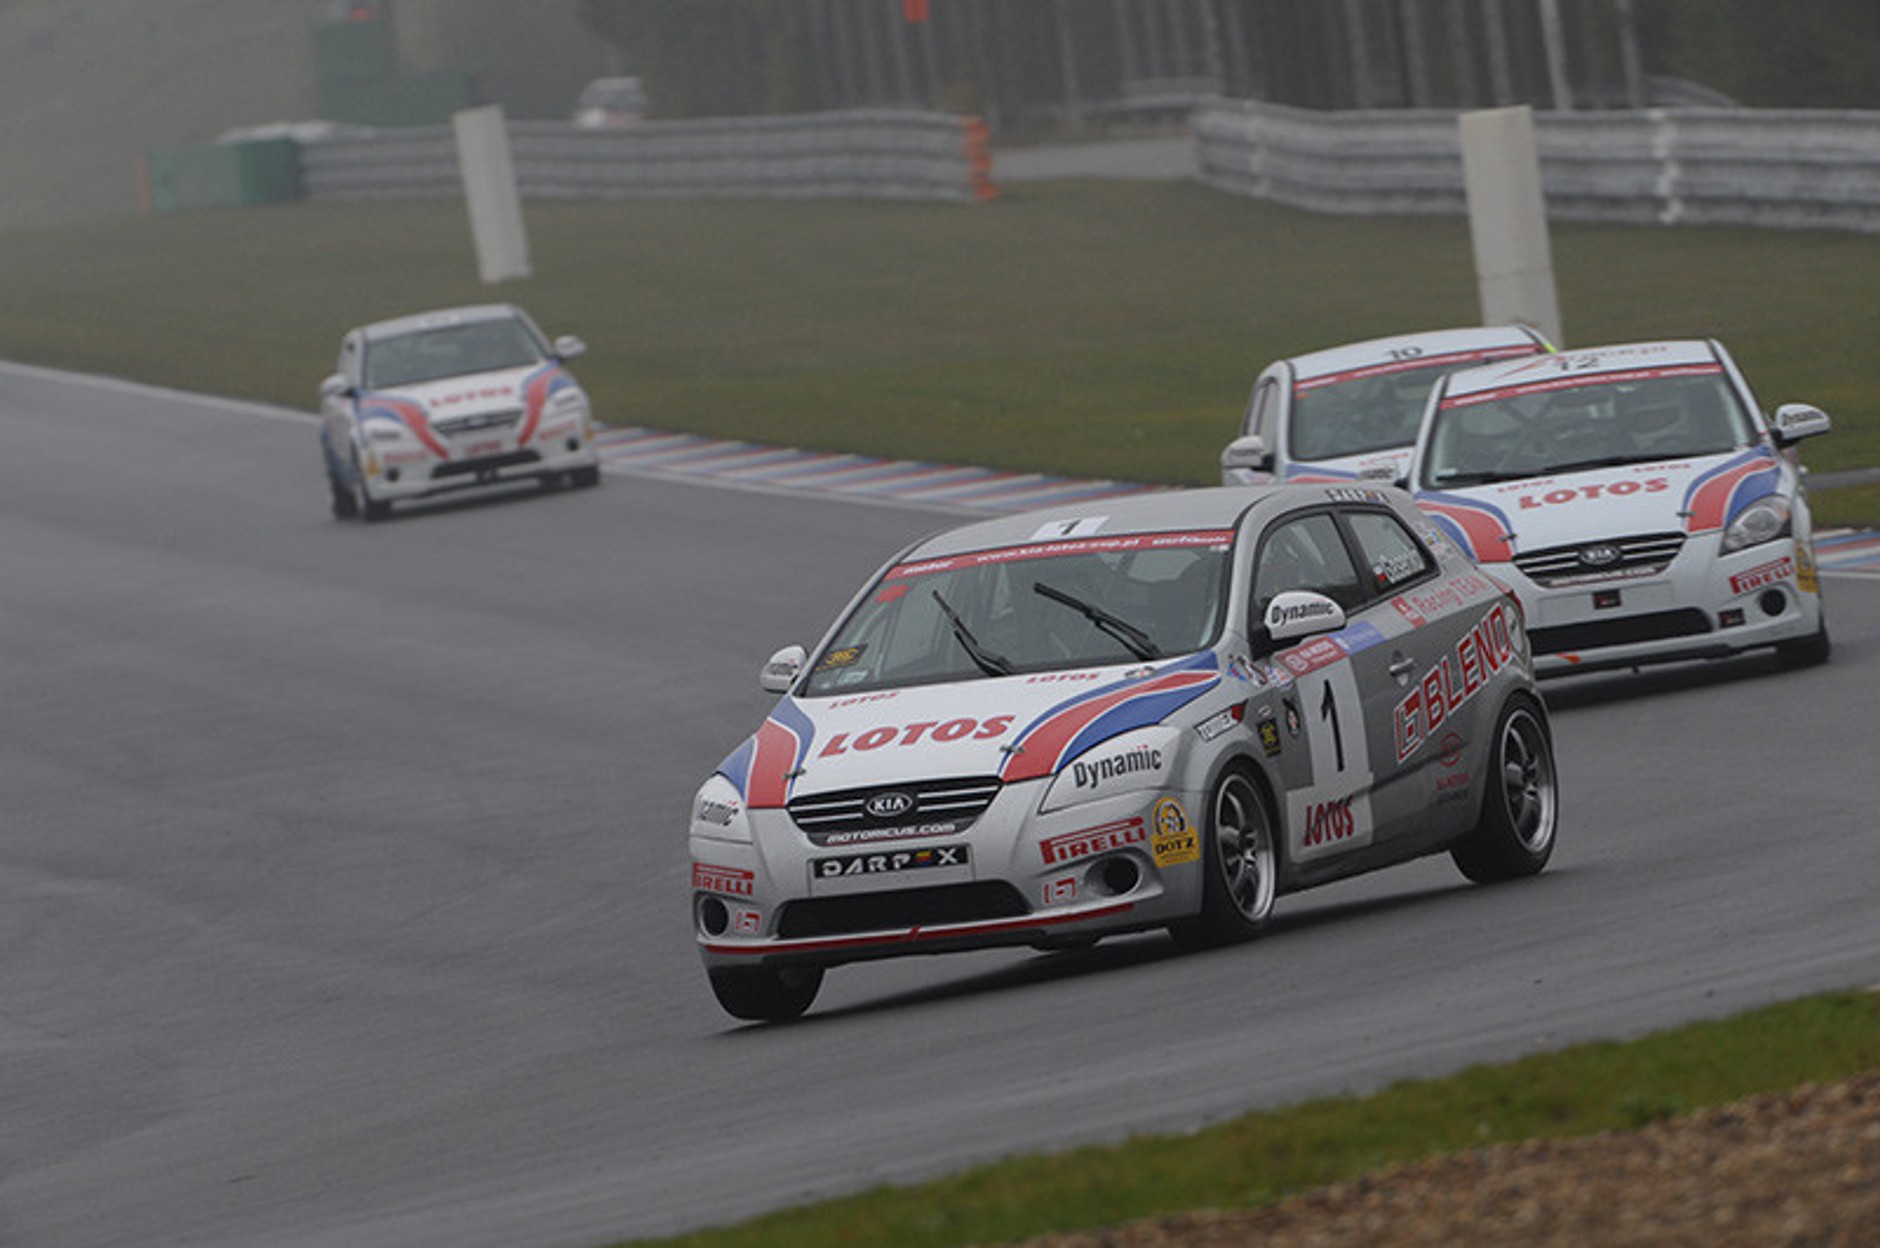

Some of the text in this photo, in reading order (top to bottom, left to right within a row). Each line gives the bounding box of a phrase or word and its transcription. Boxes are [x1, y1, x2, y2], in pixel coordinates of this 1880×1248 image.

[1518, 476, 1668, 510] LOTOS
[1270, 601, 1334, 626] Dynamic
[1026, 672, 1100, 684] LOTOS
[829, 692, 898, 710] LOTOS
[818, 714, 1016, 759] LOTOS
[1320, 678, 1345, 772] 1
[1073, 744, 1163, 790] Dynamic
[872, 797, 906, 812] KIA
[1304, 795, 1354, 847] LOTOS
[1039, 816, 1147, 865] PIRELLI
[1155, 837, 1195, 855] DOTZ
